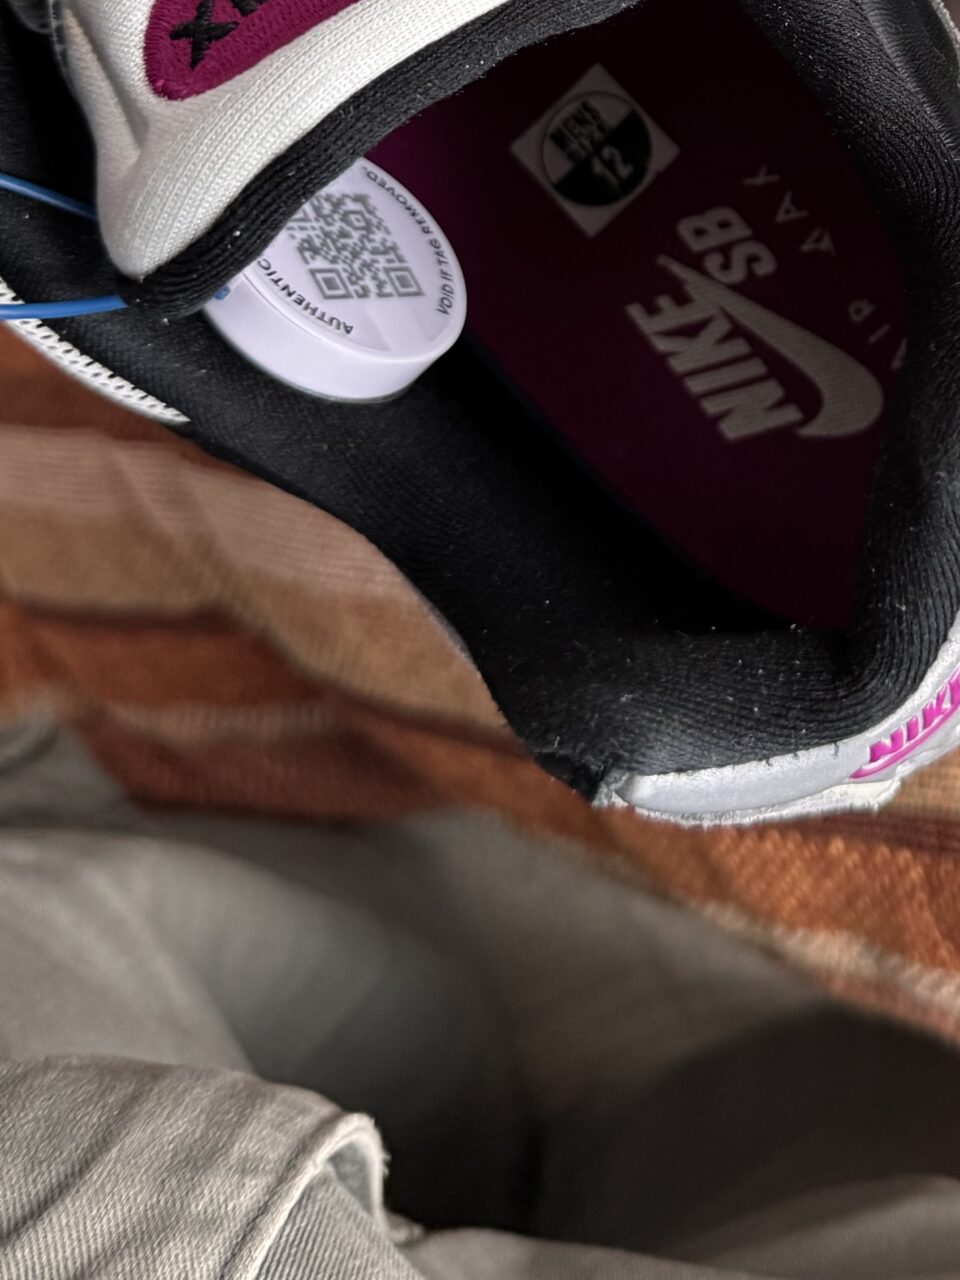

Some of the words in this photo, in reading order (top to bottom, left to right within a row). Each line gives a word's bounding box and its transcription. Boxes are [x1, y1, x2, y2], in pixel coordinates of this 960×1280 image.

[592, 143, 634, 187] 12
[429, 238, 449, 269] TAG
[677, 206, 778, 286] SB
[256, 257, 354, 335] AUTHENTIC
[436, 286, 455, 315] VOID
[625, 294, 805, 440] NIKE
